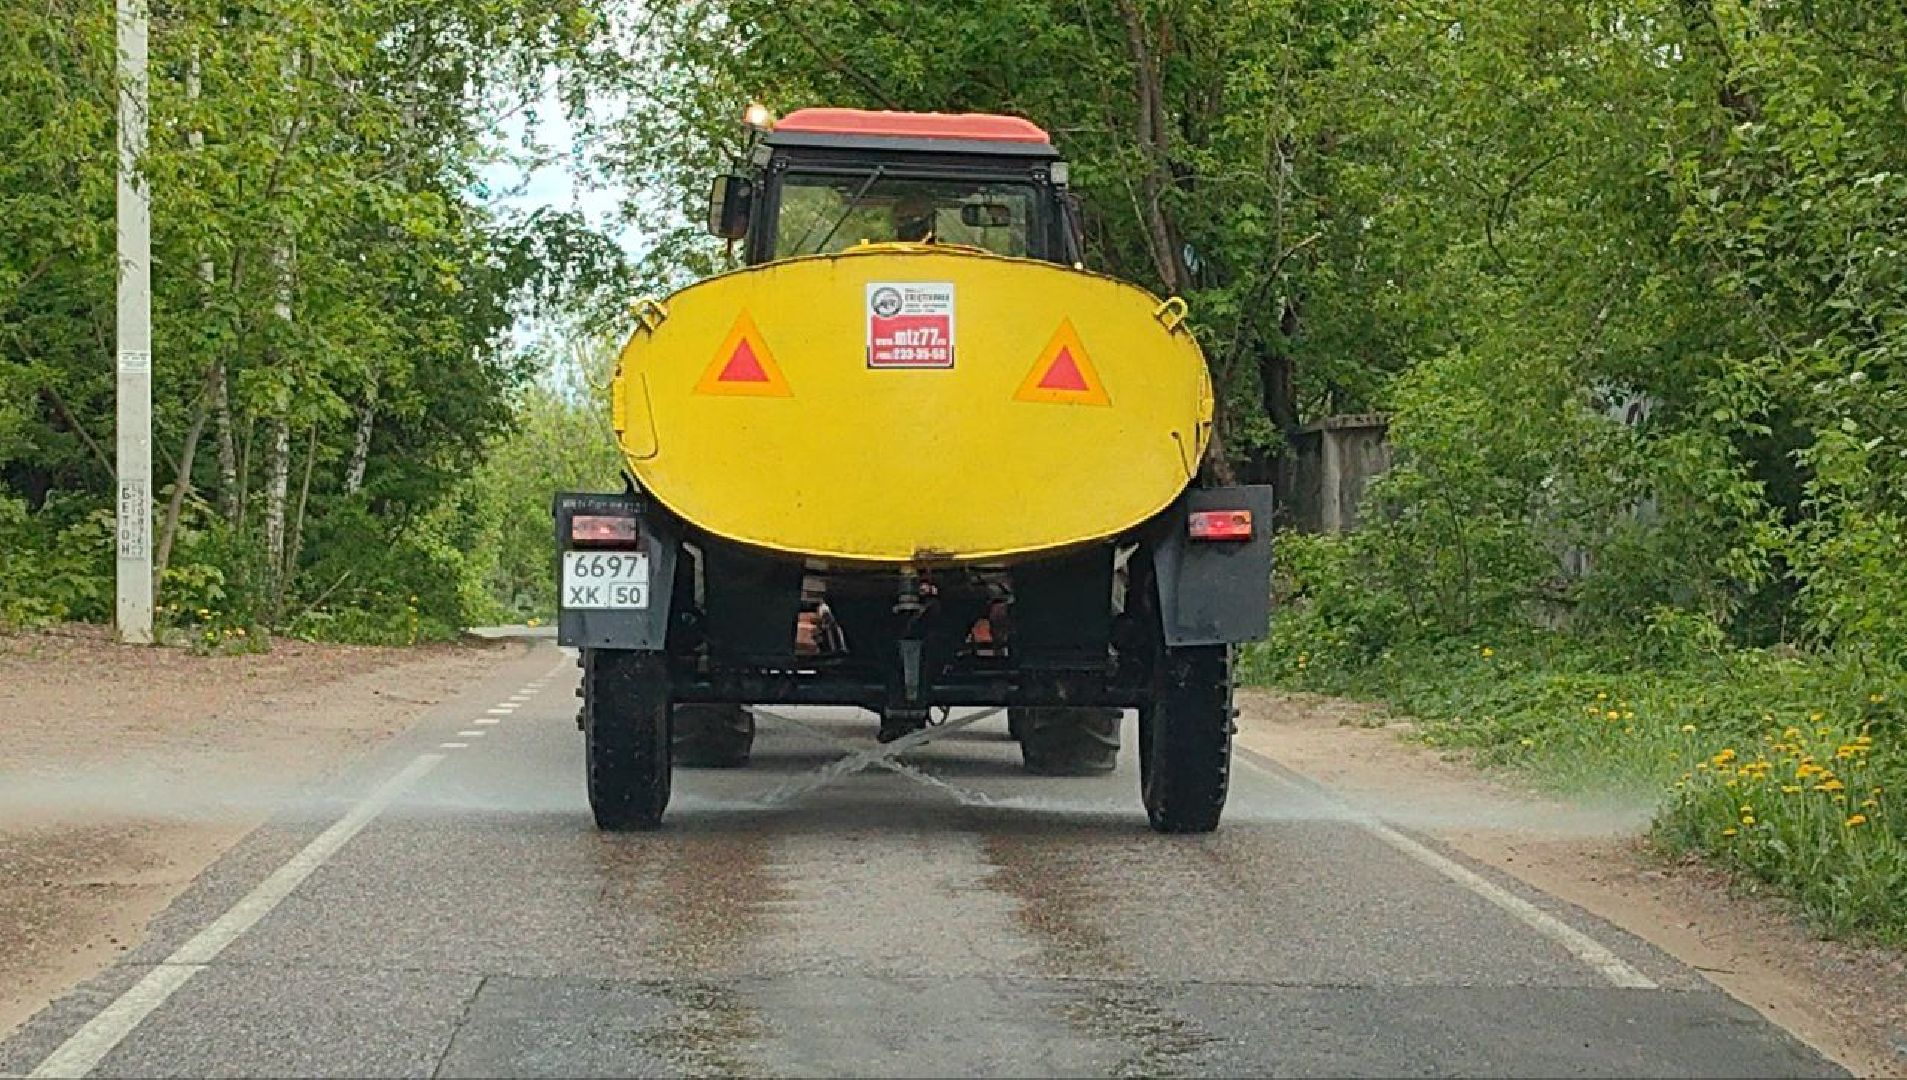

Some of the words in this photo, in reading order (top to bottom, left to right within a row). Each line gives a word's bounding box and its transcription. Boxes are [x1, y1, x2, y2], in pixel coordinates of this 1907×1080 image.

[121, 487, 130, 555] БЕТОН
[574, 555, 638, 578] 6697
[569, 586, 600, 605] ХК
[615, 586, 641, 605] 50
